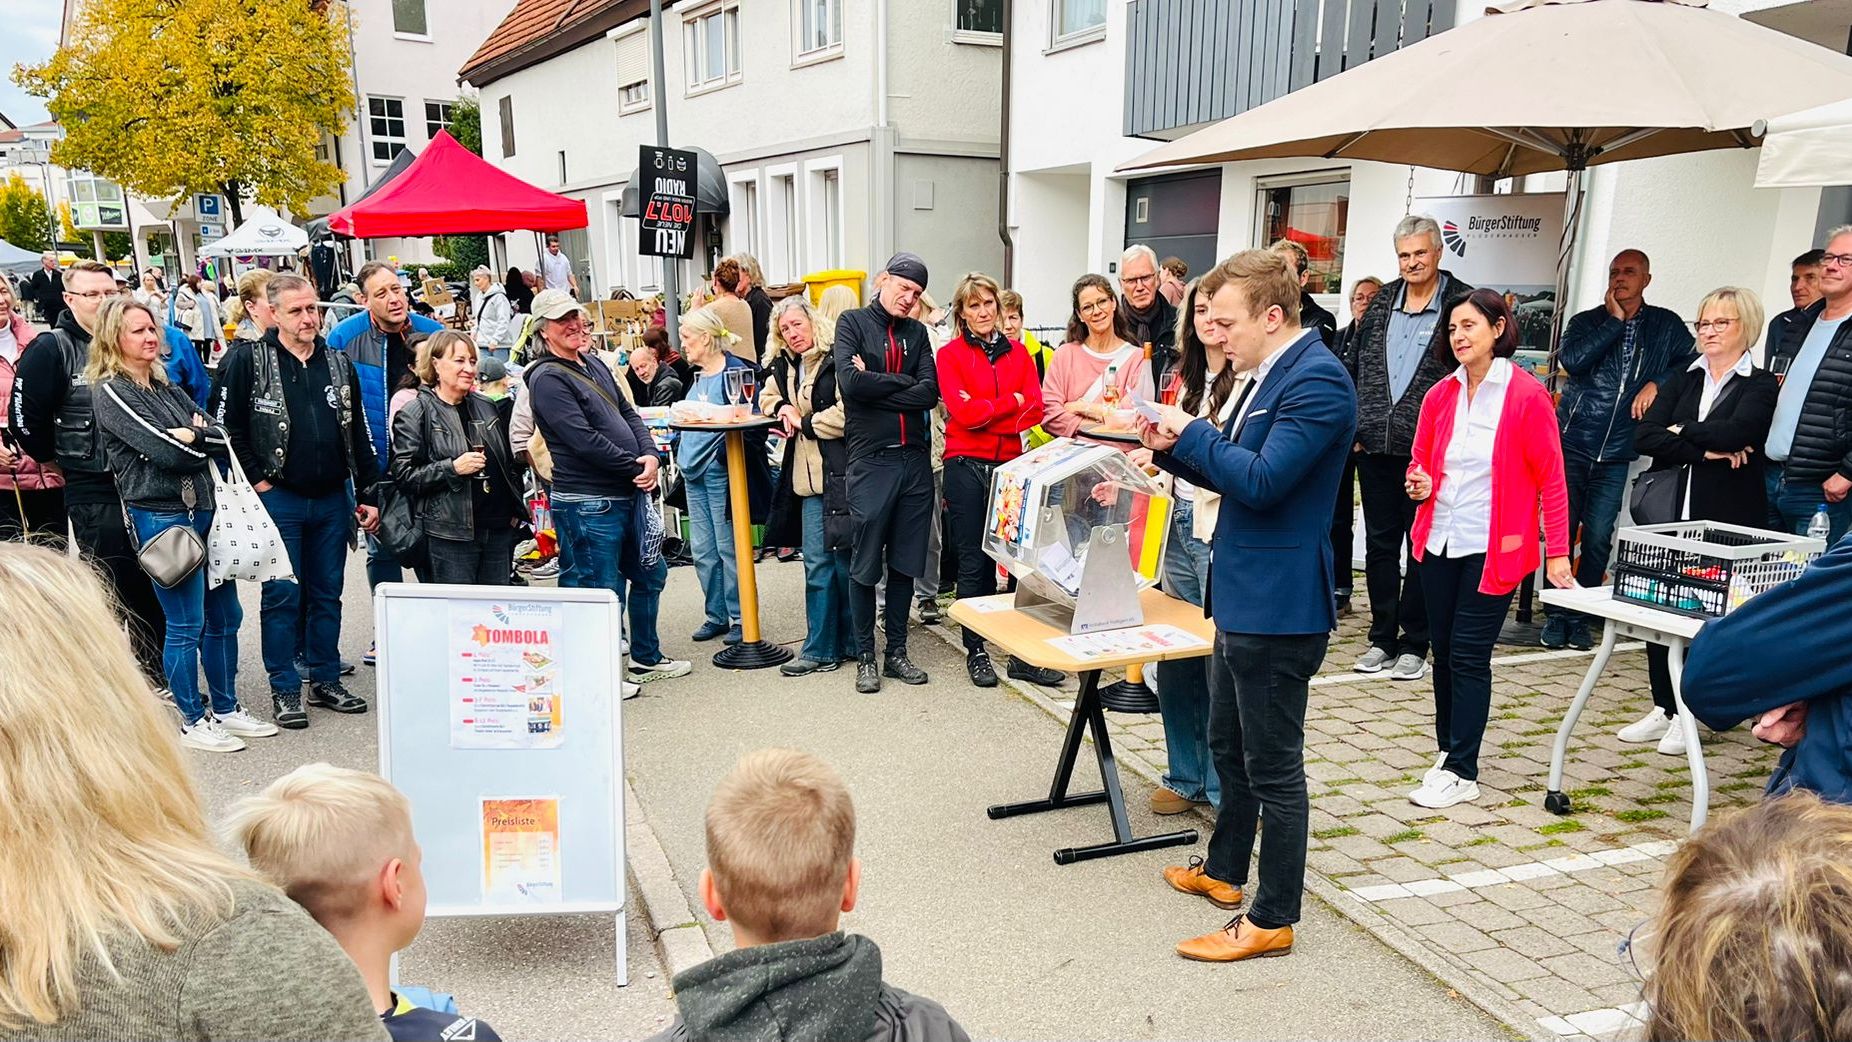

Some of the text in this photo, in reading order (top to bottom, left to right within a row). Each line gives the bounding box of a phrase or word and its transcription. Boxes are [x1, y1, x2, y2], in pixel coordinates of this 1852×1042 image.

[655, 177, 686, 197] RADIO
[203, 198, 214, 212] P
[645, 200, 692, 224] 107.7
[656, 220, 682, 229] DIE NEUE
[1468, 215, 1541, 232] BürgerStiftung
[655, 229, 686, 255] NEU
[486, 629, 549, 644] TOMBOLA
[491, 817, 536, 826] Preisliste
